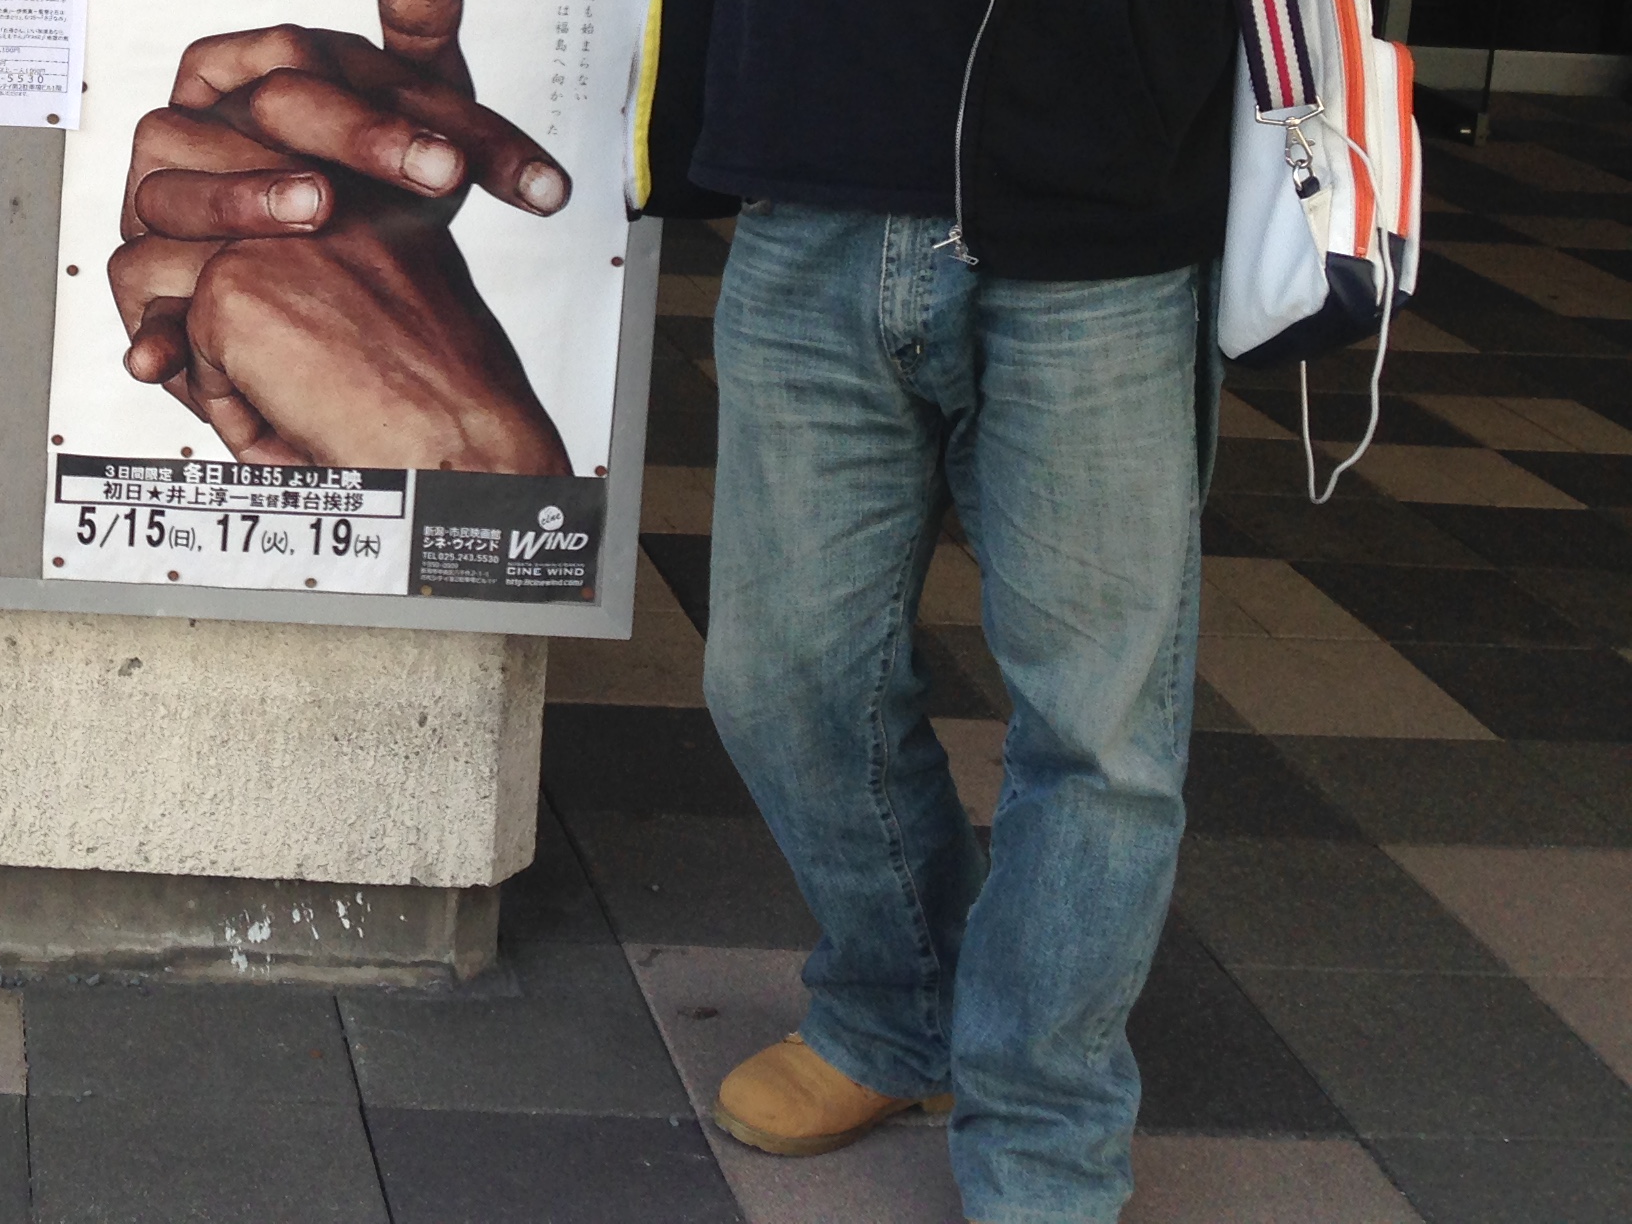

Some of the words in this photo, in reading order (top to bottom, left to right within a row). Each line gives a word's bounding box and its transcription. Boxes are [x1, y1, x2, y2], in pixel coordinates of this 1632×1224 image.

[105, 464, 172, 482] 3日間限定
[183, 463, 223, 483] 各日
[231, 465, 282, 486] 16:55
[289, 469, 362, 490] より上映
[423, 537, 499, 551] シネ・ウインド
[506, 567, 542, 576] CINE
[547, 567, 585, 576] WIND
